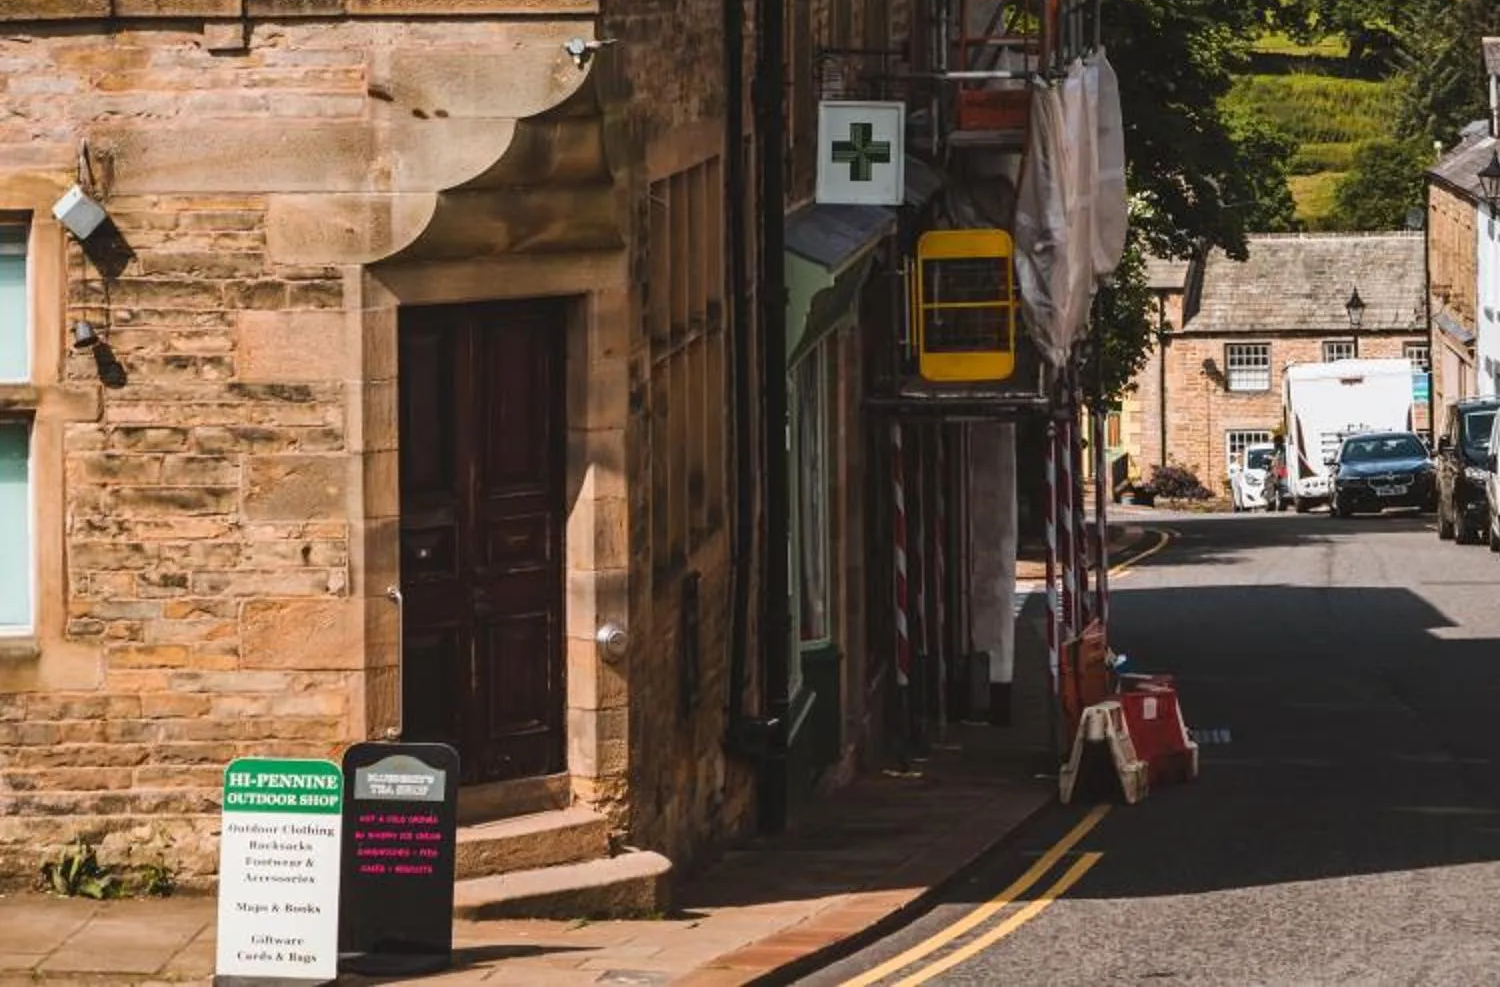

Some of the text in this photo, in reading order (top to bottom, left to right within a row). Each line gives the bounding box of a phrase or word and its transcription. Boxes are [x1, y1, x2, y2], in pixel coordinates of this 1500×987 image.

[228, 772, 339, 790] HI-PENNINE
[226, 792, 339, 807] OUTDOOR SHOP
[227, 823, 336, 838] Outdoor Clothing
[245, 856, 314, 868] Footwear &
[243, 872, 316, 884] Accessories
[236, 902, 321, 914] Maps & Books
[250, 935, 304, 946] Giftware
[237, 951, 318, 964] Cards & Bags
